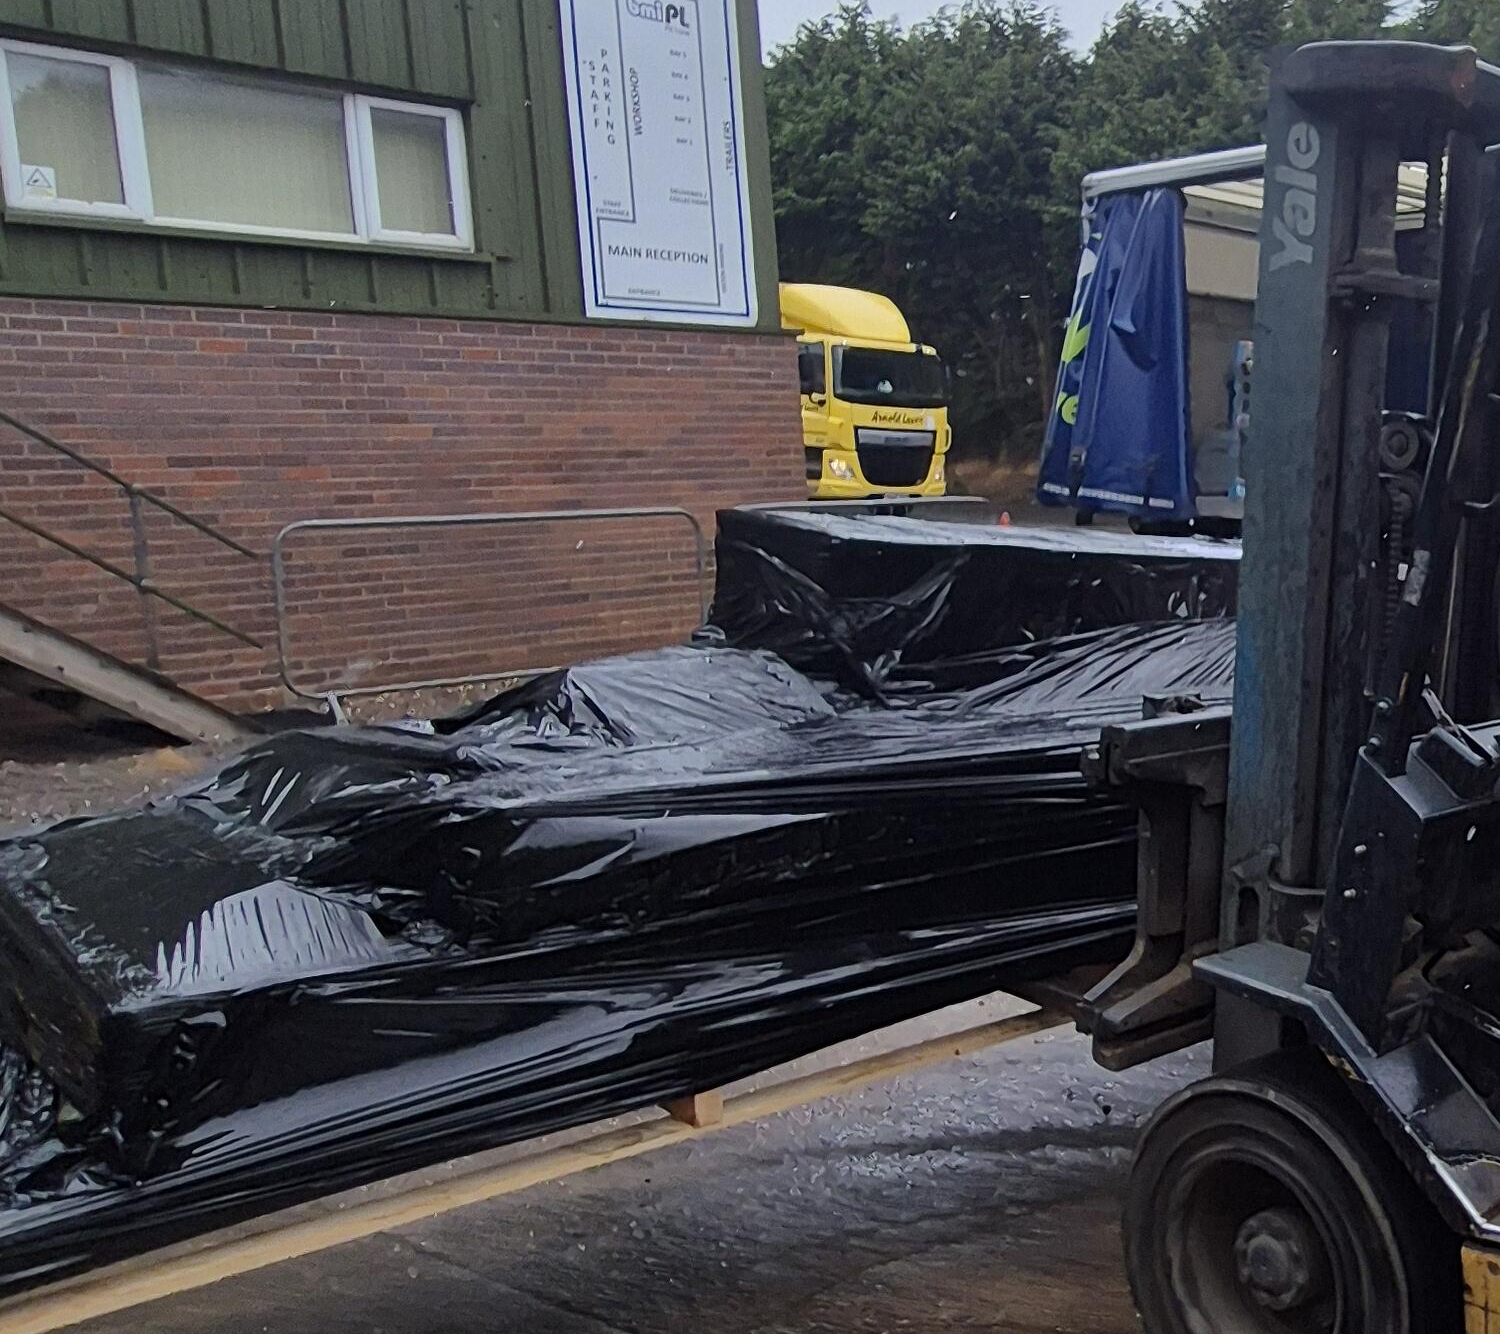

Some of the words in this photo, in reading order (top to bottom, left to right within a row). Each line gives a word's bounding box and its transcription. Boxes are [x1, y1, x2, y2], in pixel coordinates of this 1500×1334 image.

[601, 49, 615, 145] PARKING
[629, 67, 643, 136] WORKSHOP
[723, 120, 733, 171] TRAILERS
[1268, 121, 1320, 272] Yale
[608, 245, 642, 259] MAIN
[645, 248, 709, 265] RECEPTION
[871, 410, 901, 424] Arnold
